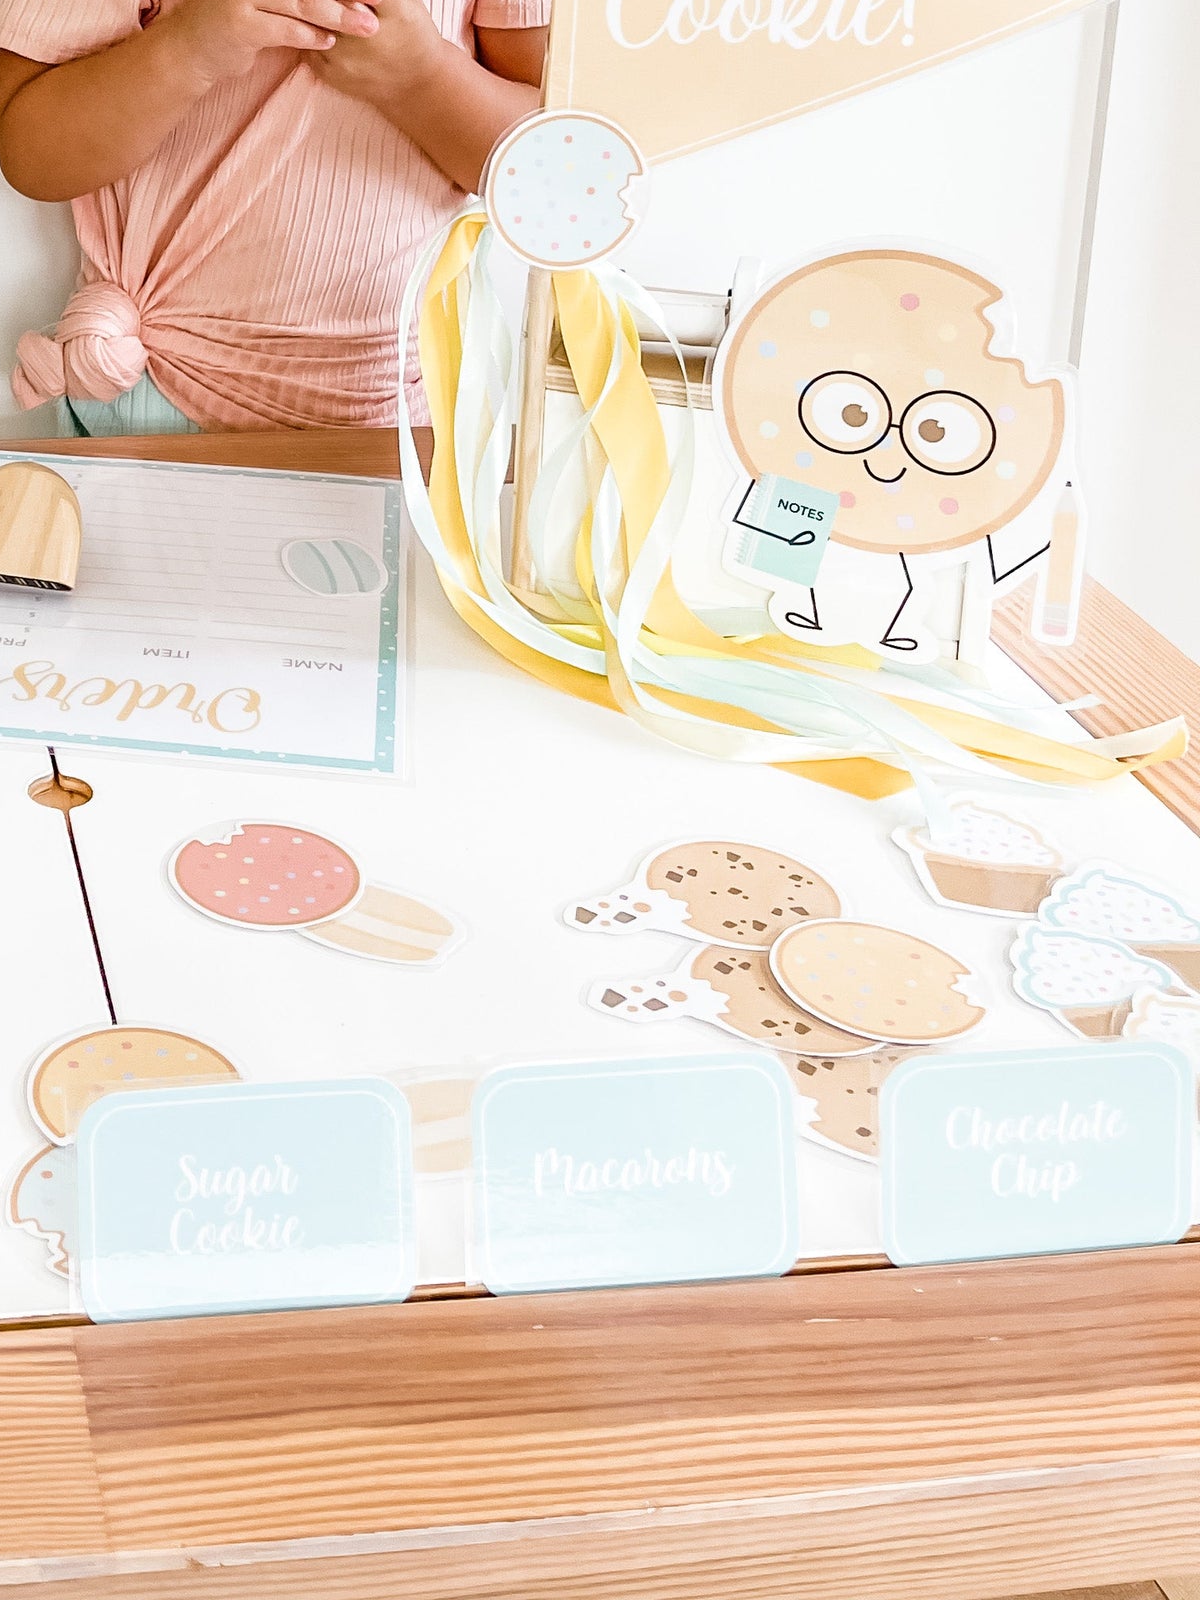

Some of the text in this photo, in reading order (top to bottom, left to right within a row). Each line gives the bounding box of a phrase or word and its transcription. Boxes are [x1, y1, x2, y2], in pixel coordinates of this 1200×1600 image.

[777, 498, 825, 521] NOTES
[142, 646, 191, 659] ITEM
[281, 658, 344, 672] NAME
[946, 1100, 1128, 1151] Chocolate
[175, 1153, 299, 1215] Sugar
[533, 1147, 736, 1197] Macarons
[992, 1152, 1083, 1203] Chip
[170, 1205, 304, 1255] Cookie
